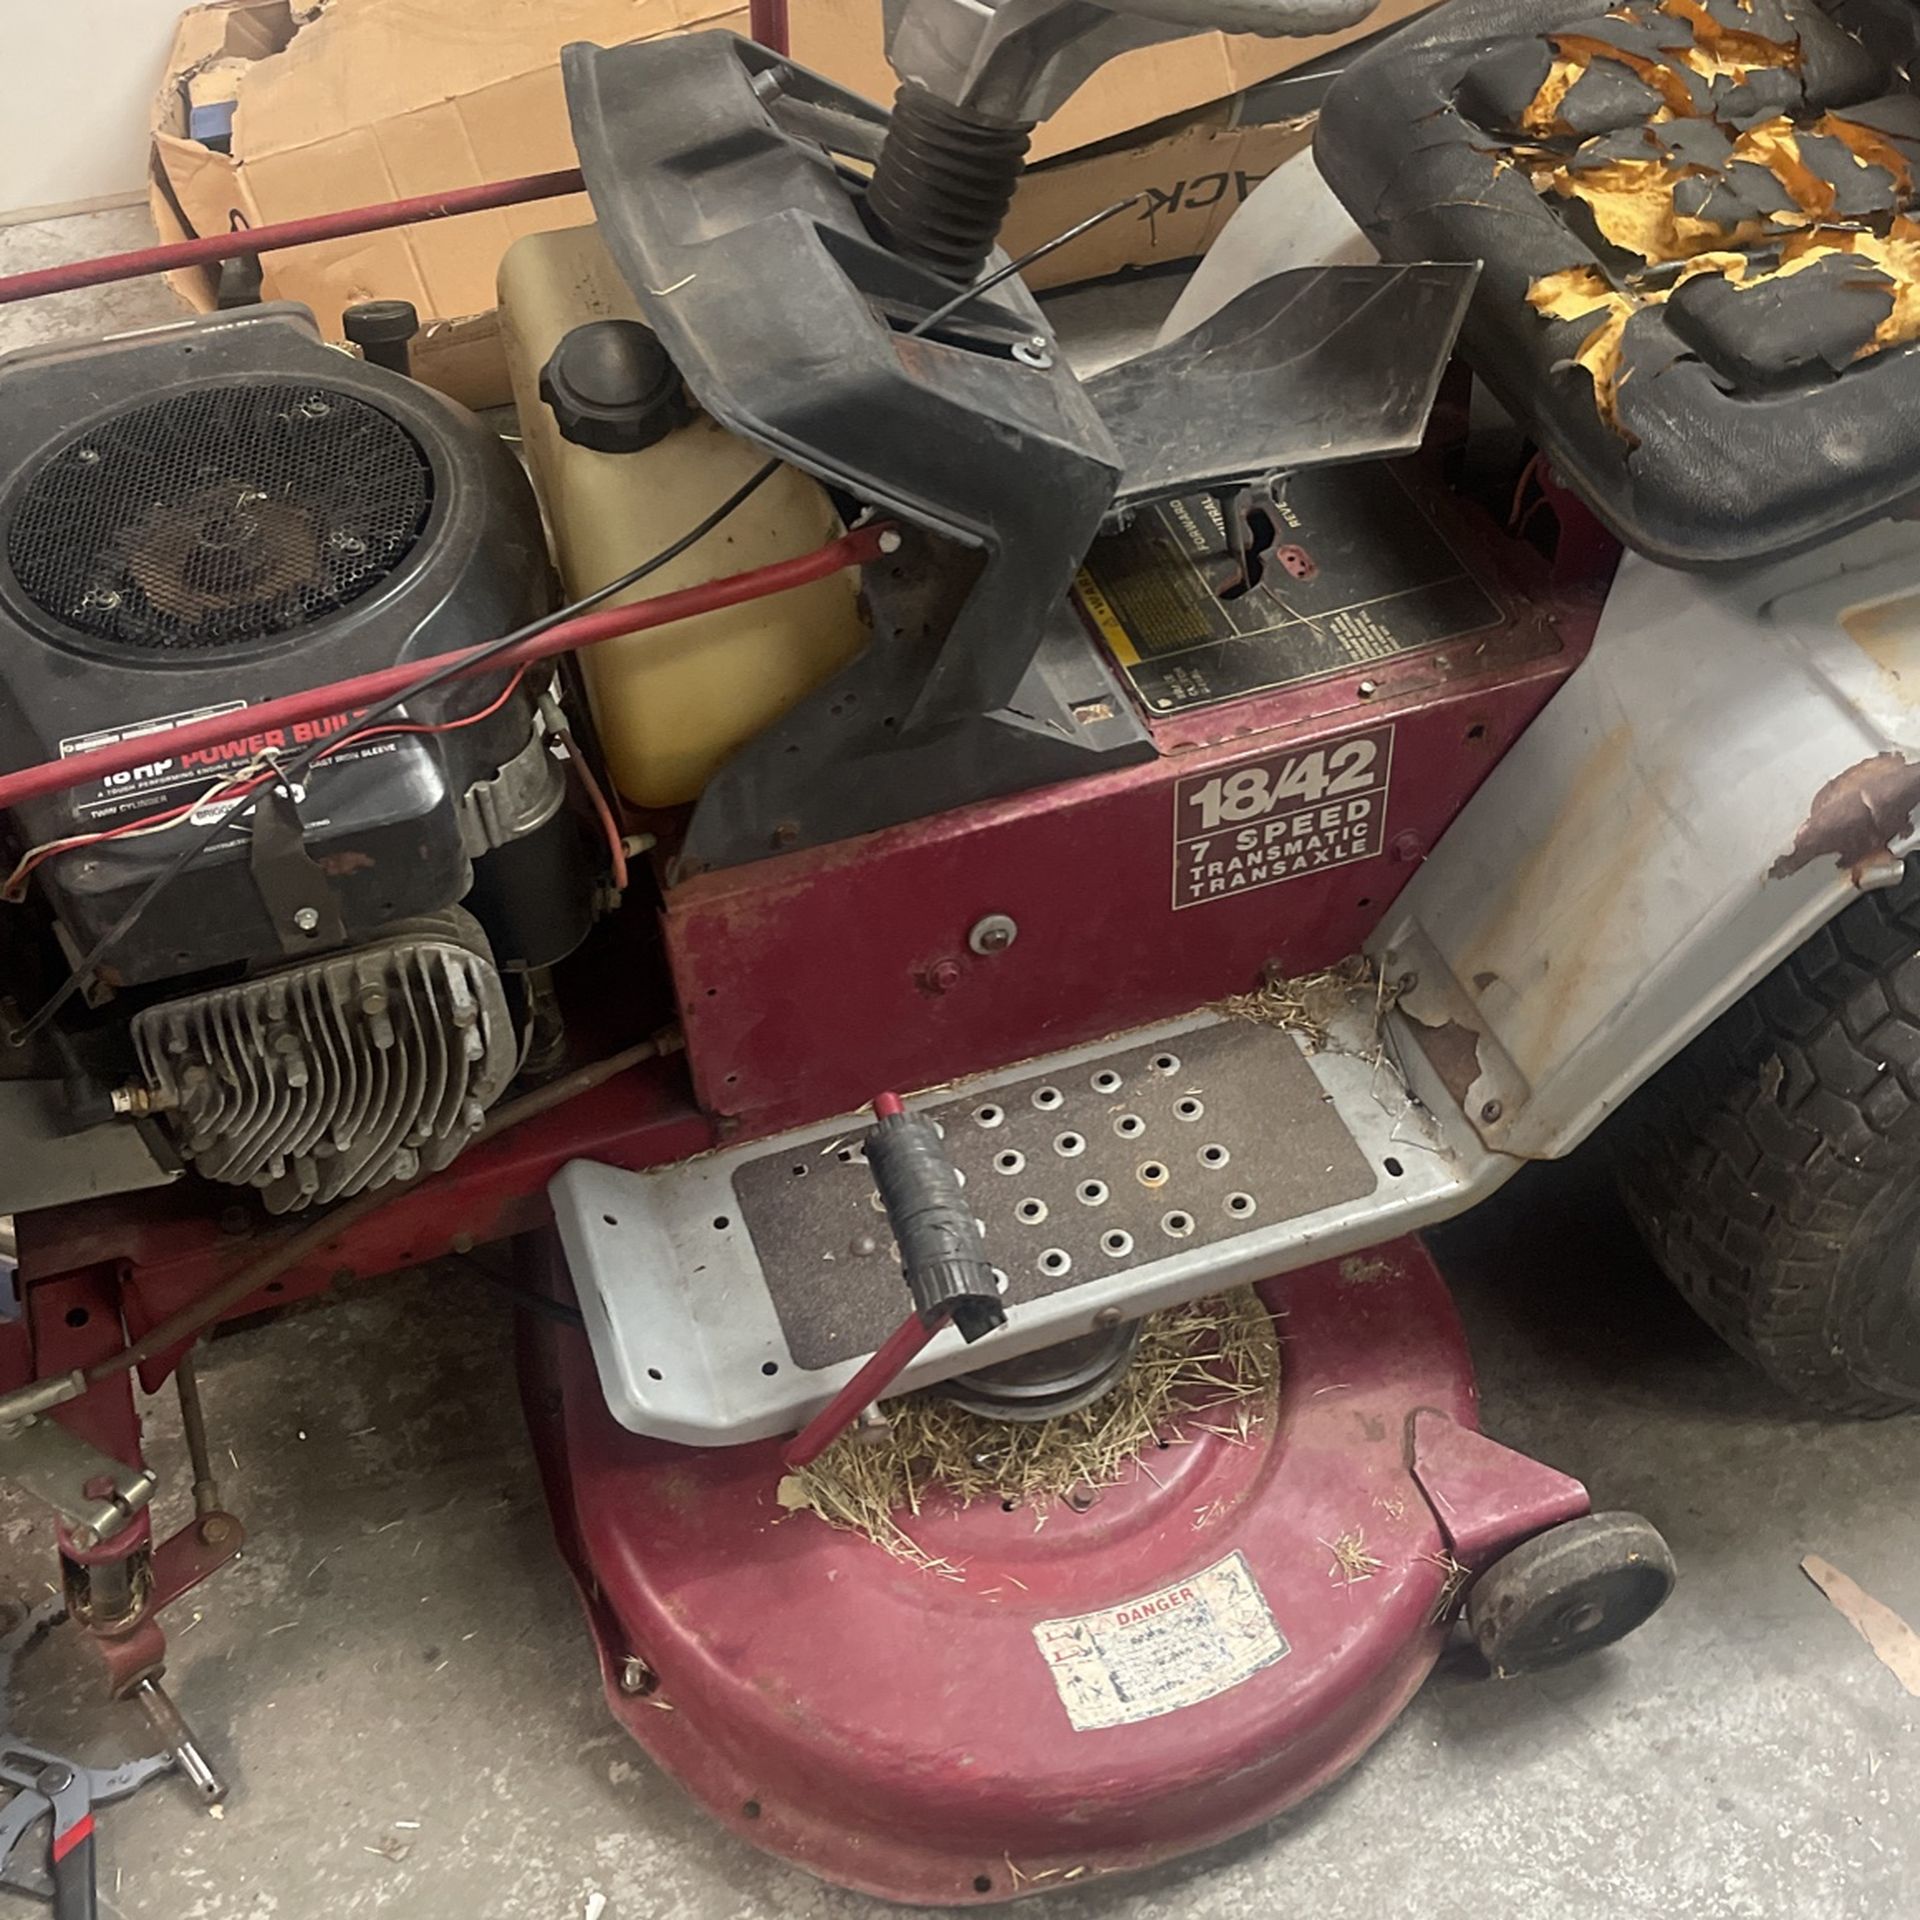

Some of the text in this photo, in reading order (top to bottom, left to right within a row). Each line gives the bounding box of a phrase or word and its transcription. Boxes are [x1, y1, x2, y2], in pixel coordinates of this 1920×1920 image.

[1137, 168, 1276, 221] ACK
[1169, 499, 1210, 552] FORWARD
[1275, 501, 1301, 528] REVE
[1076, 567, 1105, 610] WARN
[181, 729, 285, 768] POWER
[293, 709, 368, 743] BUIL
[335, 750, 360, 763] IRON
[361, 743, 397, 757] SLEEVE
[138, 770, 195, 789] PERFORMING
[1190, 740, 1378, 829] 18/42
[91, 795, 168, 819] TWIN CYLINDER
[1191, 799, 1371, 863] 7 SPEED
[1189, 839, 1366, 897] TRANSAXLE
[1190, 822, 1368, 881] TRANSMATIC
[1116, 1587, 1195, 1627] DANGER
